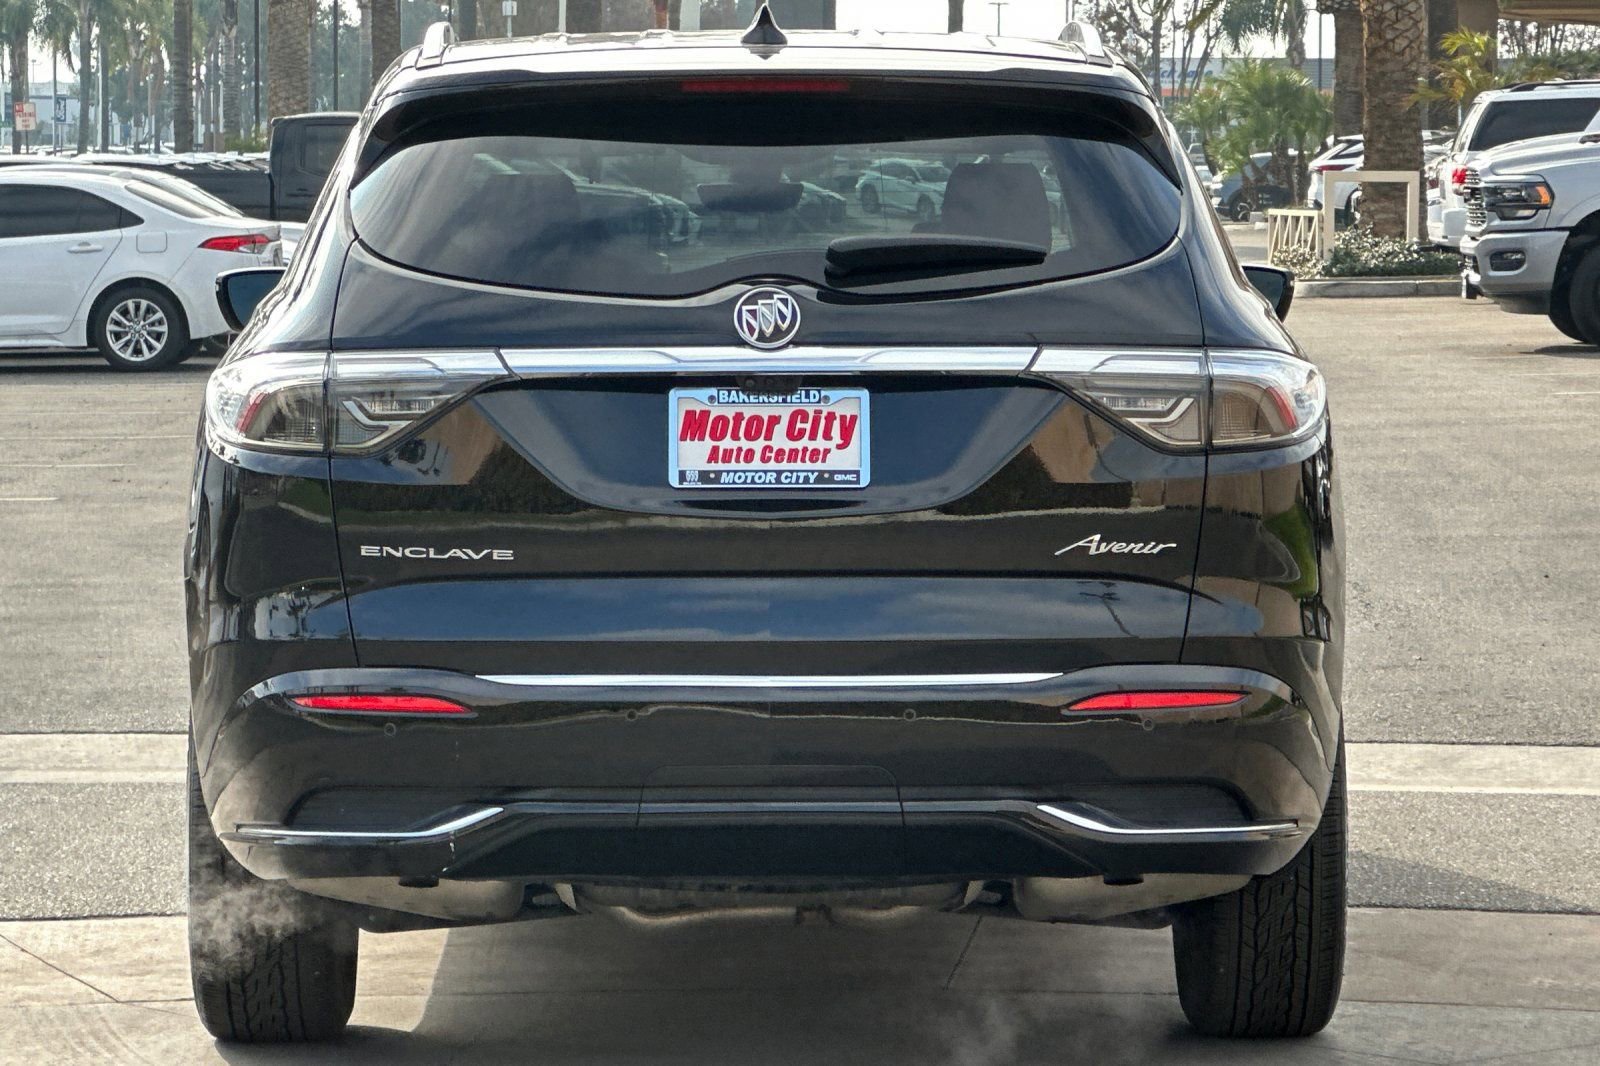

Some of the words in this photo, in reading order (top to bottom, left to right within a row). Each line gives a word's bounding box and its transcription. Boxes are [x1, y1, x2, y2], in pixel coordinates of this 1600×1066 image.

[718, 389, 821, 403] BAKERSFIELD
[679, 409, 781, 442] Motor
[786, 409, 858, 450] City
[707, 445, 756, 464] Auto
[760, 445, 832, 464] Center
[720, 471, 776, 484] MOTOR
[780, 471, 819, 484] CITY
[833, 474, 858, 482] GMC
[360, 545, 514, 561] ENCLAVE
[1054, 533, 1178, 556] Avenir
